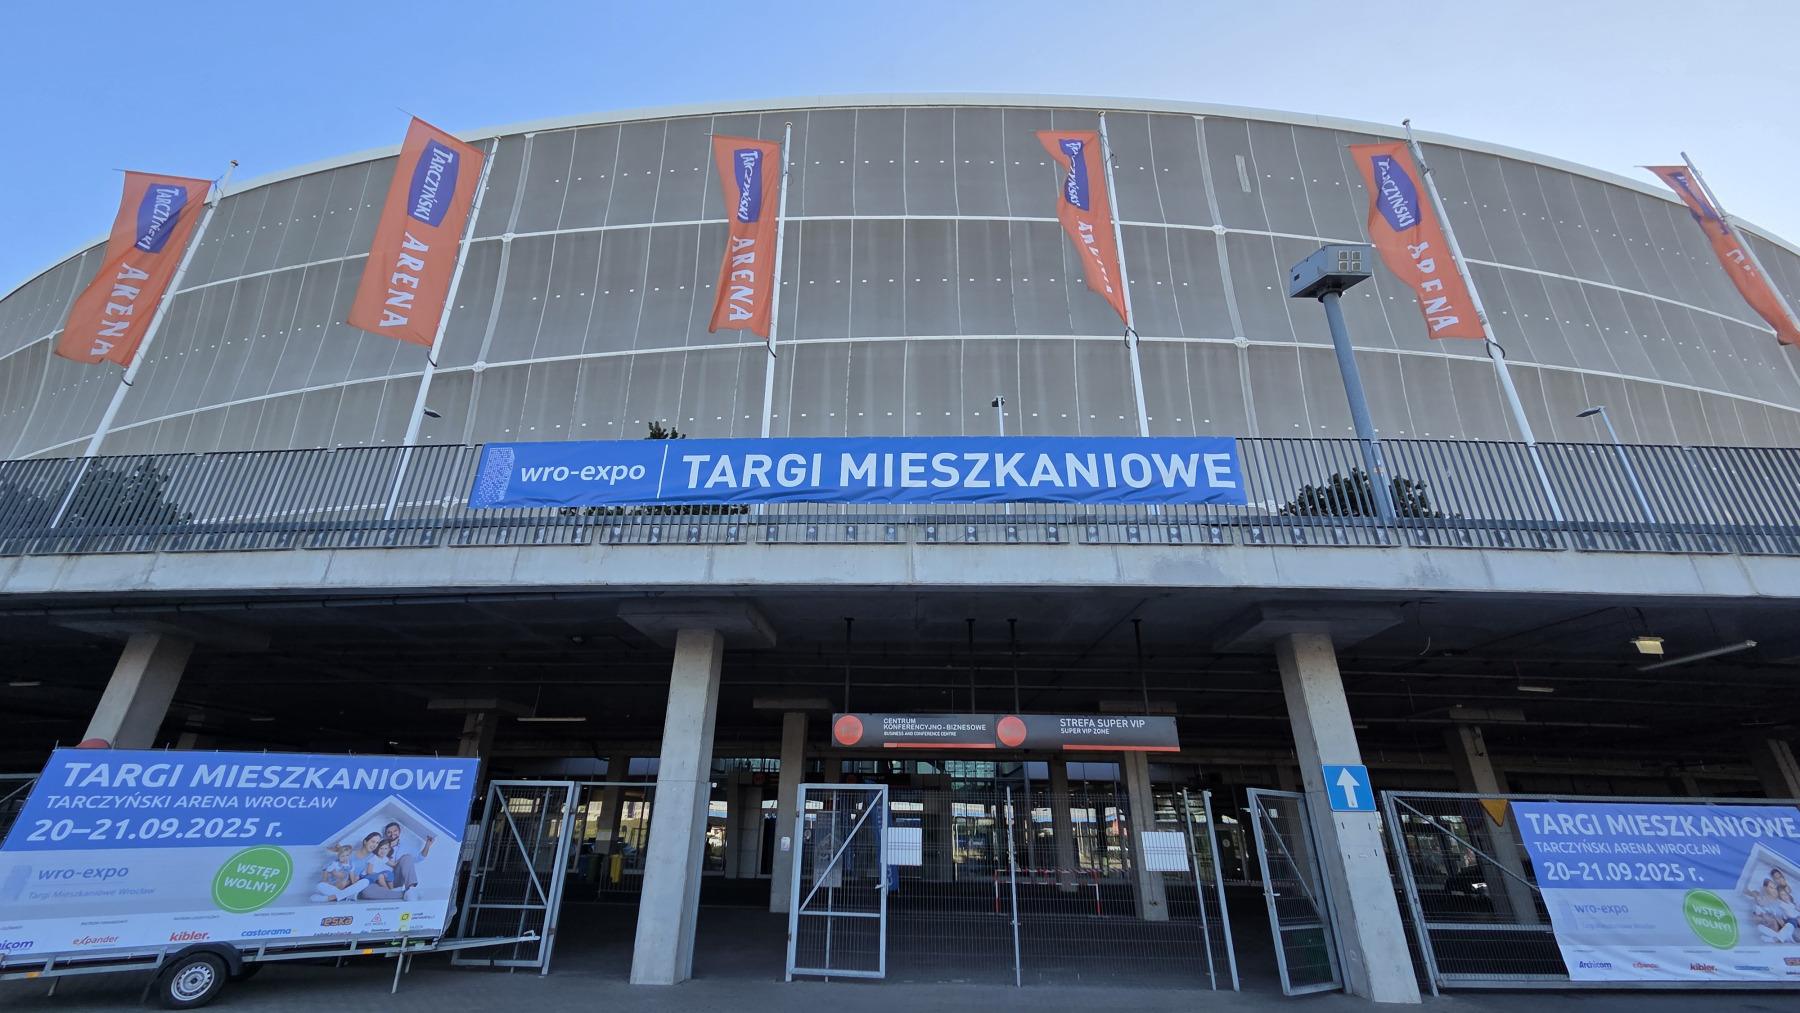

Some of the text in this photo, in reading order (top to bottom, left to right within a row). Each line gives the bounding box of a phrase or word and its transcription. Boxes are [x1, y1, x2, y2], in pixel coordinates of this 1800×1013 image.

[414, 148, 453, 221] TARCZYŃSKI
[737, 151, 758, 221] TARCZYŃSKI
[379, 232, 430, 327] ARENA
[729, 236, 755, 321] ARENA
[521, 460, 646, 486] wro-expo
[682, 452, 1236, 489] TARGI MIESZKANIOWE
[1060, 718, 1145, 728] STREFA SUPER VIP
[64, 762, 464, 791] TARGI MIESZKANIOWE
[47, 791, 338, 808] TARCZYŃSKI ARENA WROCŁAW
[26, 817, 282, 842] 20–21.09.2025 r.
[1524, 813, 1800, 838] TARGI MIESZKANIOWE
[1533, 838, 1720, 856] TARCZYŃSKI ARENA WROCŁAW
[38, 867, 129, 881] wro-expo
[236, 863, 280, 880] WSTĘP
[1688, 867, 1704, 882] r.
[224, 876, 277, 893] WOLNY!
[1574, 904, 1629, 916] wro-expo
[169, 931, 210, 941] kibler.
[241, 928, 291, 937] castorama
